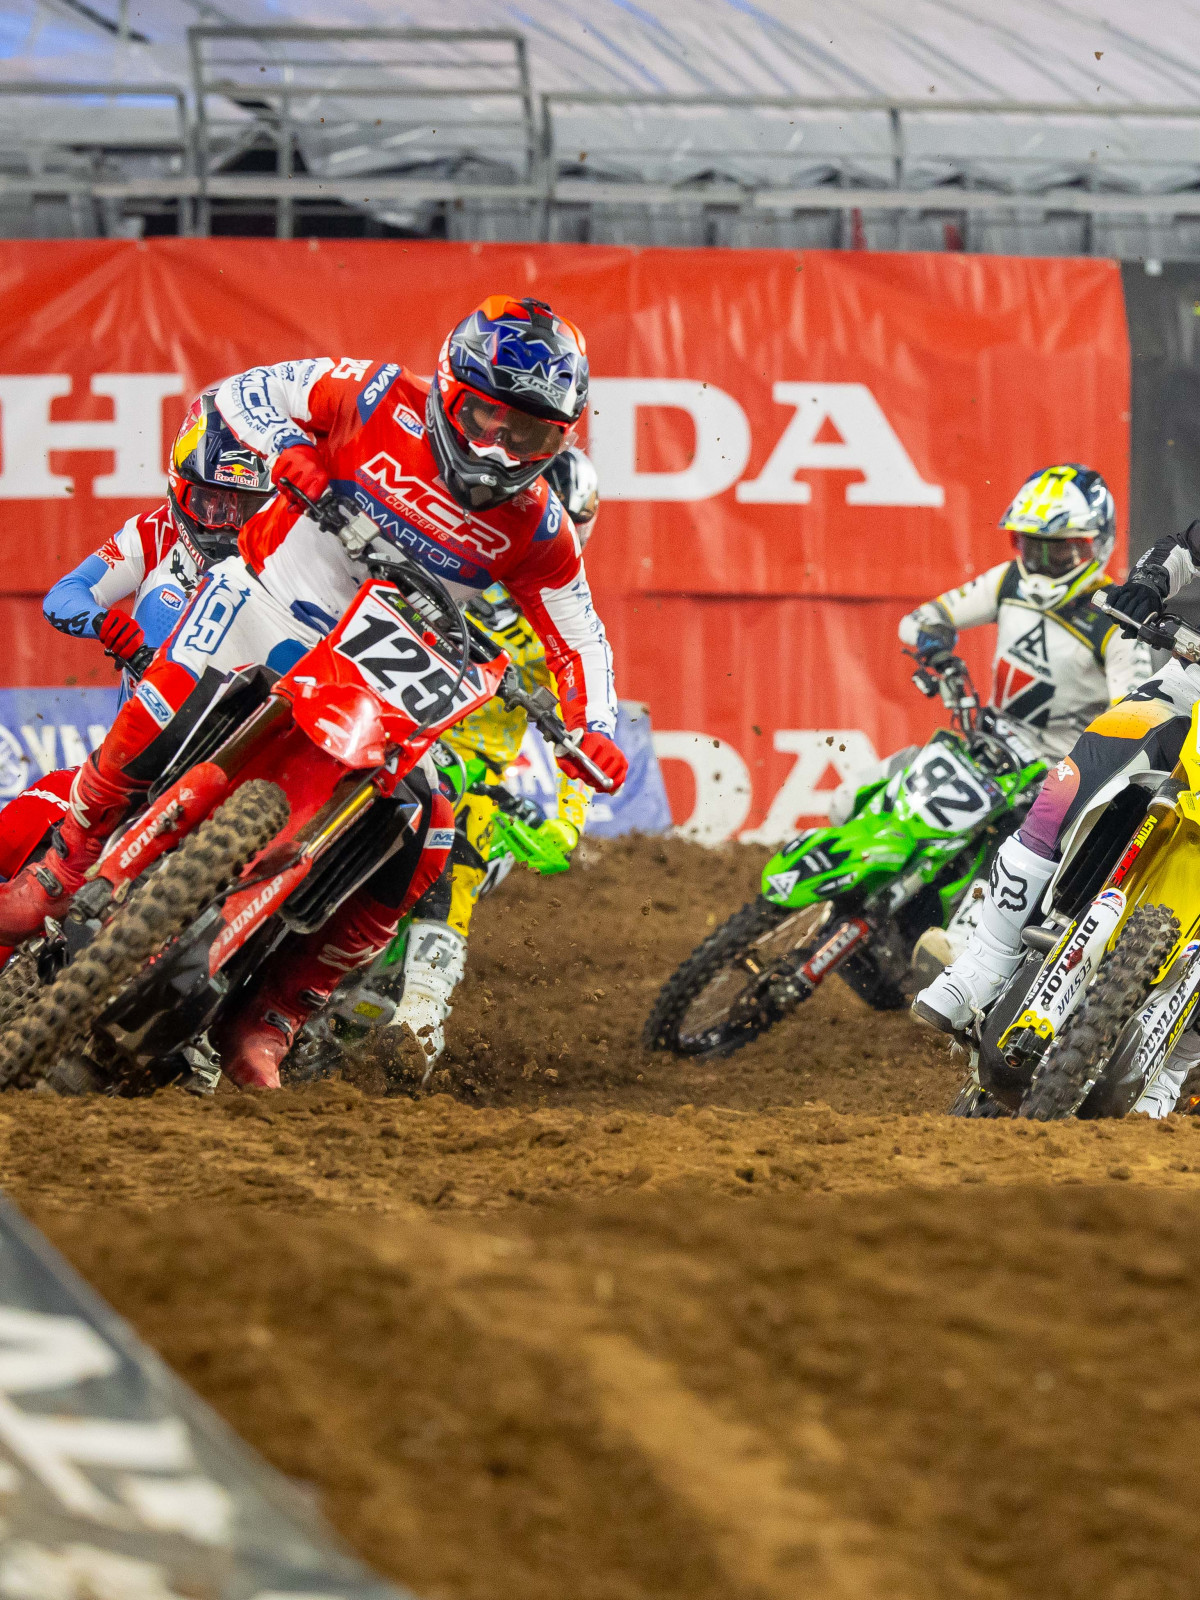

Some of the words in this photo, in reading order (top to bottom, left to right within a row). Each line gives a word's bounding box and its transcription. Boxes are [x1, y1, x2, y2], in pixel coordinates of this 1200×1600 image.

[396, 411, 424, 437] 100%
[215, 472, 237, 483] Red
[238, 474, 259, 487] Bull
[359, 450, 512, 561] MCR
[353, 490, 462, 571] SMARTOP
[162, 591, 183, 609] 100%
[337, 613, 471, 727] 125
[138, 683, 173, 724] MCR
[119, 799, 180, 869] DUNLOP
[1134, 814, 1158, 849] ACTIVE
[1111, 843, 1141, 887] RIDE
[220, 874, 285, 946] DUNLOP
[1040, 915, 1099, 1007] DUNLOP
[1057, 956, 1092, 1017] ECSTAR
